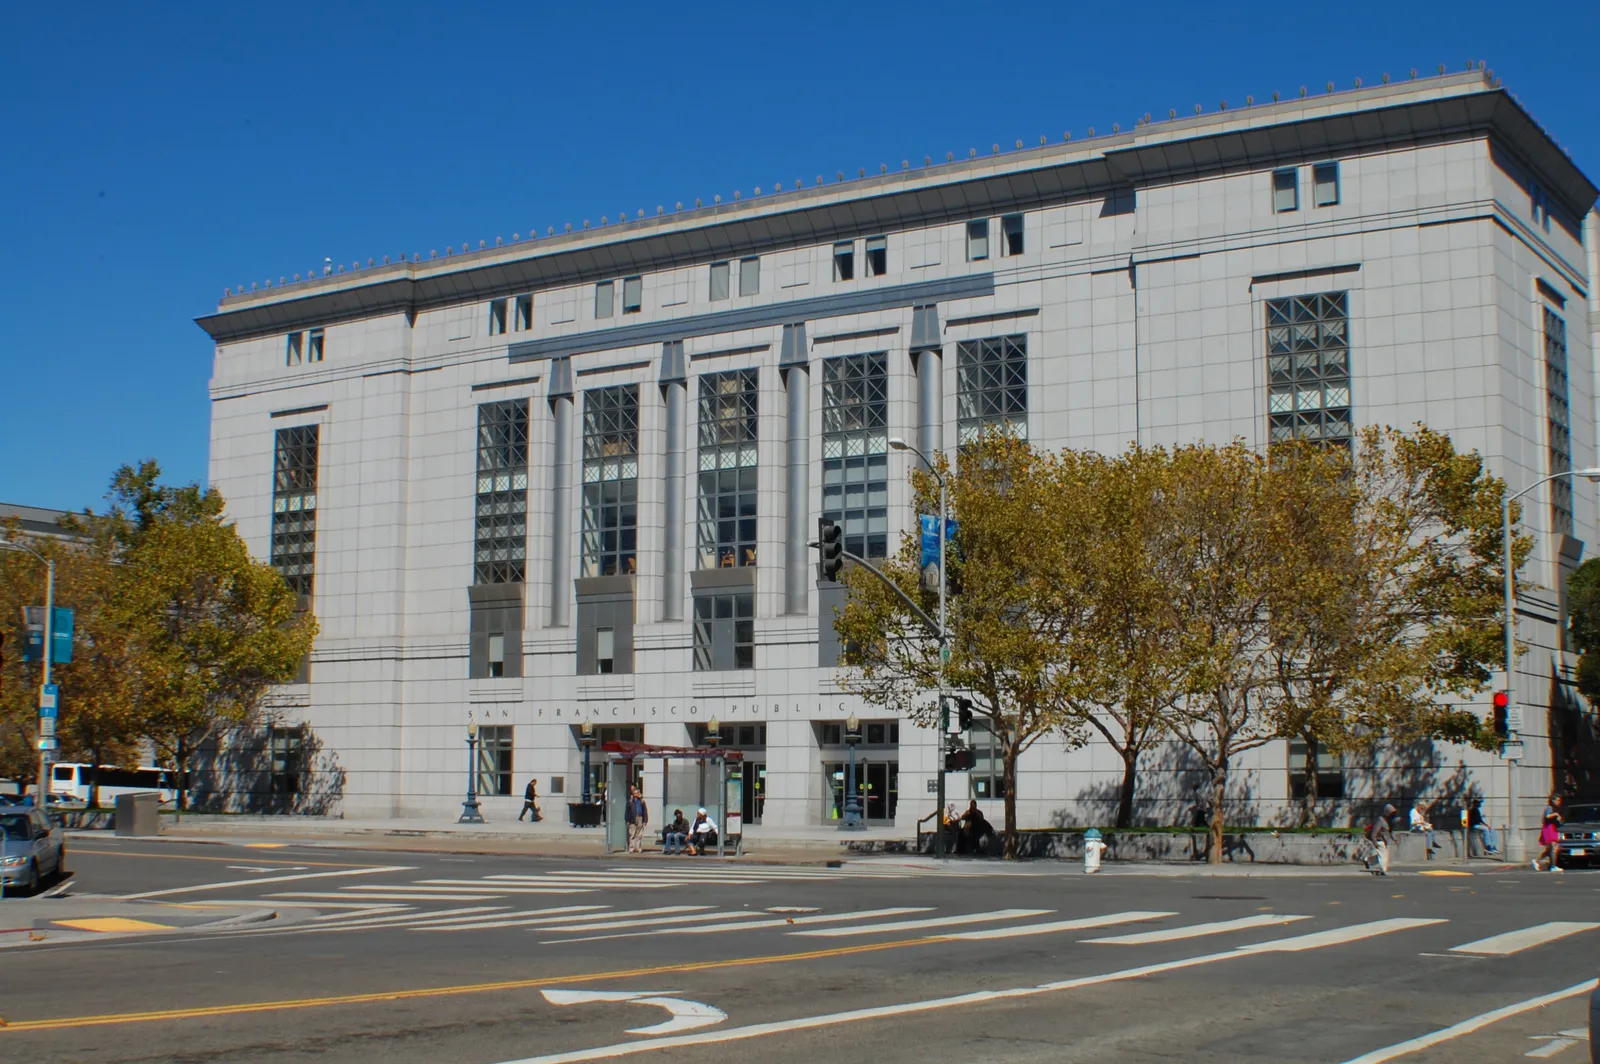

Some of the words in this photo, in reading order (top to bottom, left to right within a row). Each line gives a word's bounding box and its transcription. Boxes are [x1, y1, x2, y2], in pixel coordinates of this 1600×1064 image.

[468, 709, 508, 718] SAN
[538, 705, 698, 717] FRANCISCO
[732, 702, 845, 713] PUBLIC
